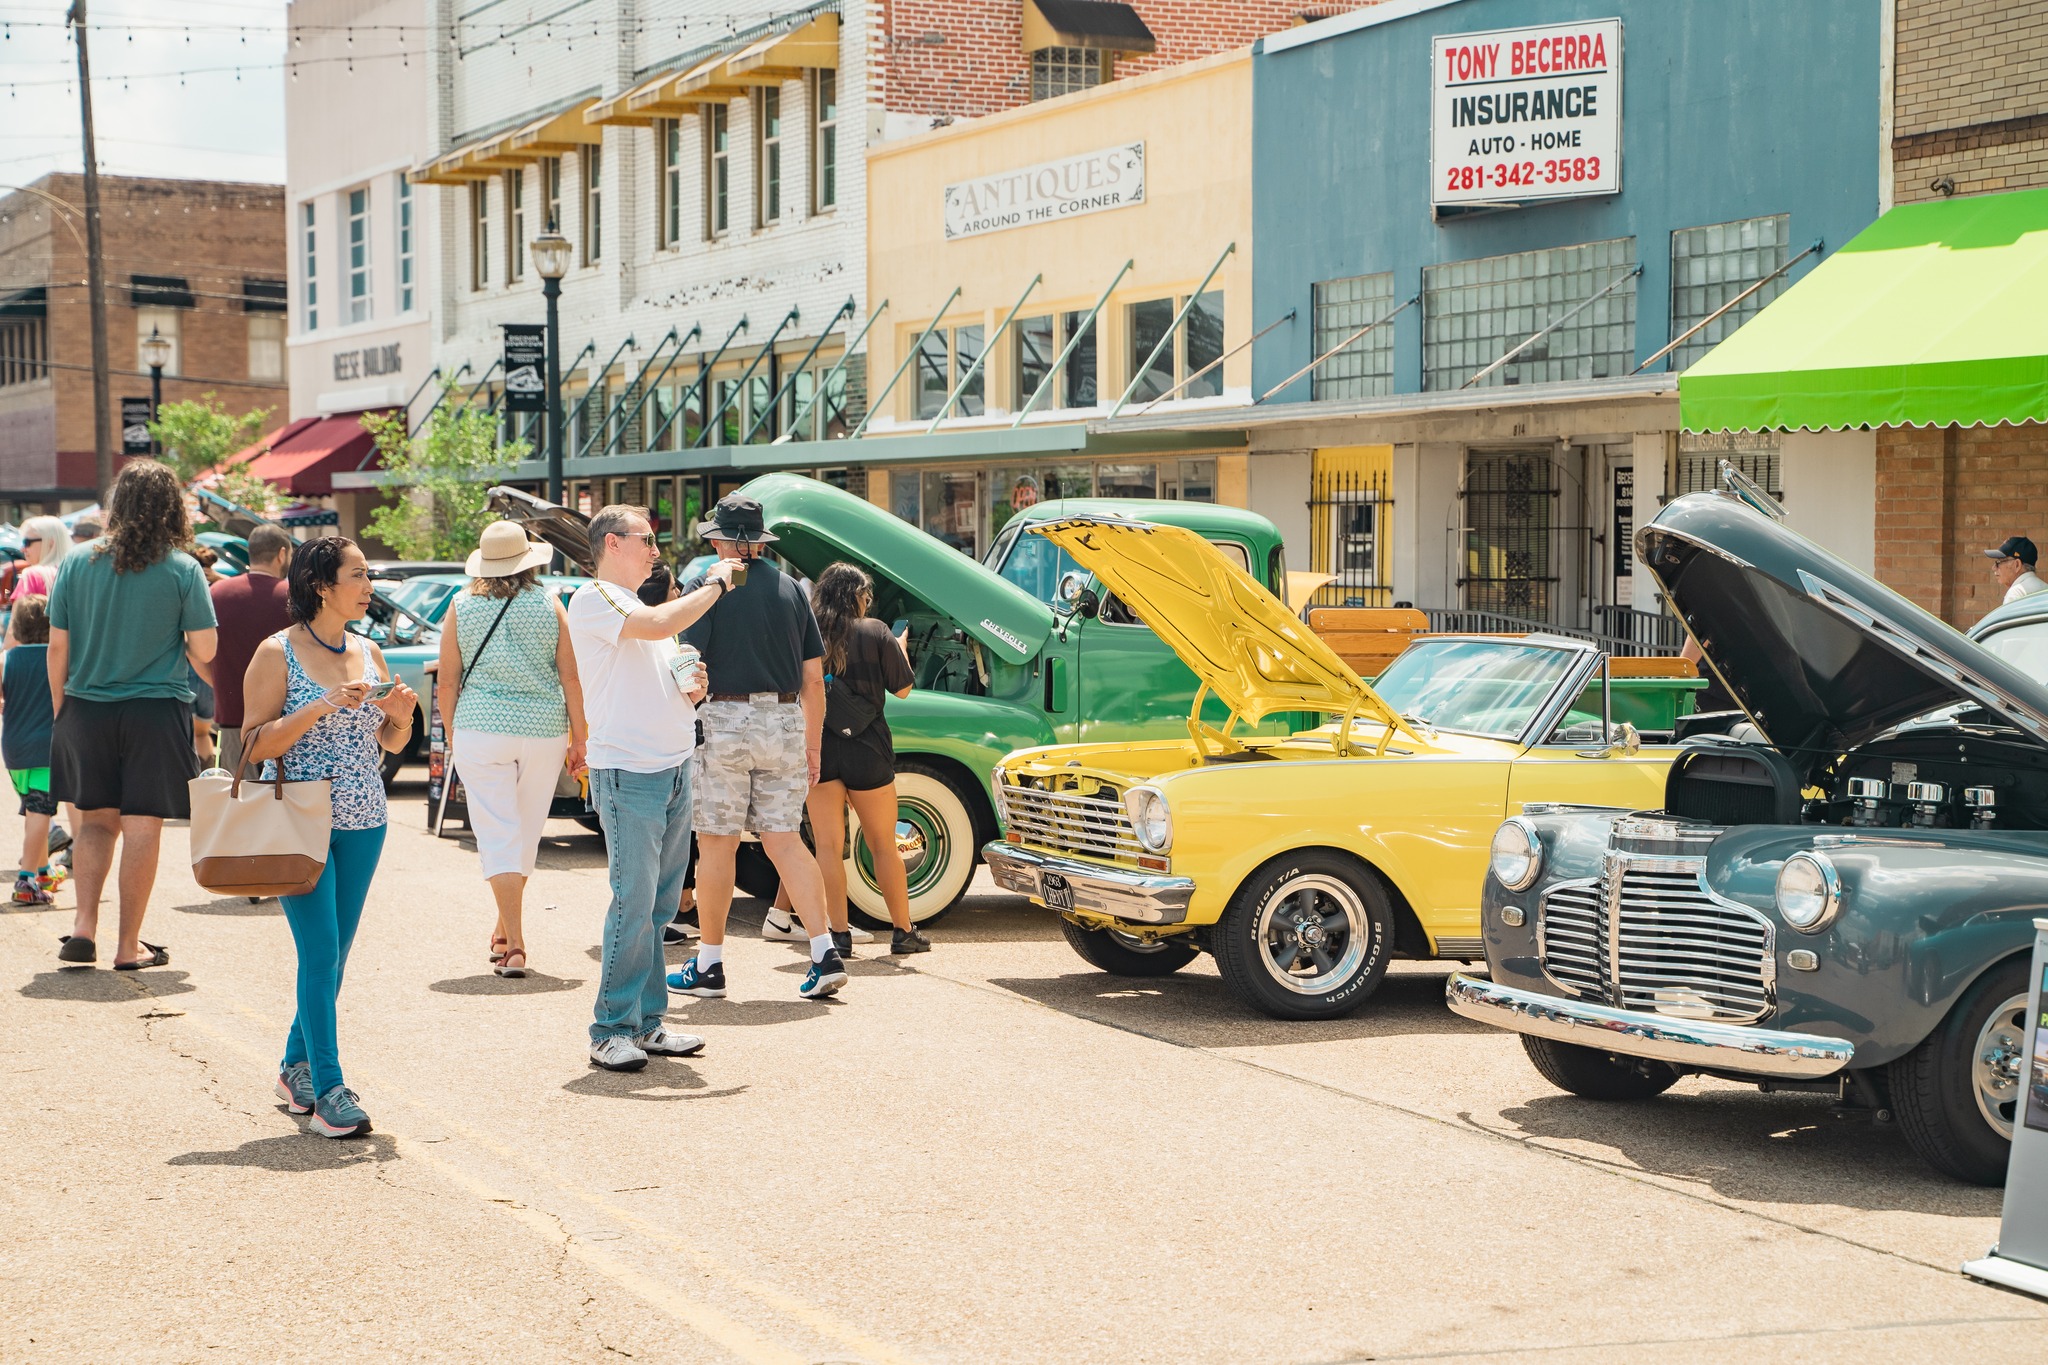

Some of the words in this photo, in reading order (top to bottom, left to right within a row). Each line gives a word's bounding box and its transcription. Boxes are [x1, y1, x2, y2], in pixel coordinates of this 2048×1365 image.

[1445, 43, 1500, 82] TONY
[1511, 33, 1607, 76] BECERRA
[1452, 85, 1597, 128] INSURANCE
[1468, 135, 1515, 156] AUTO
[1531, 130, 1581, 151] HOME
[959, 152, 1121, 219] ANTIQUES
[1447, 156, 1601, 191] 281-342-3583
[963, 212, 1021, 234] AROUND
[1026, 205, 1053, 221] THE
[1058, 192, 1121, 214] CORNER
[1011, 486, 1037, 508] OPEN
[983, 618, 1028, 651] CHEVROLET
[1046, 874, 1062, 888] 1963
[1277, 867, 1300, 884] T/A
[1326, 921, 1382, 1003] BFGoodrich
